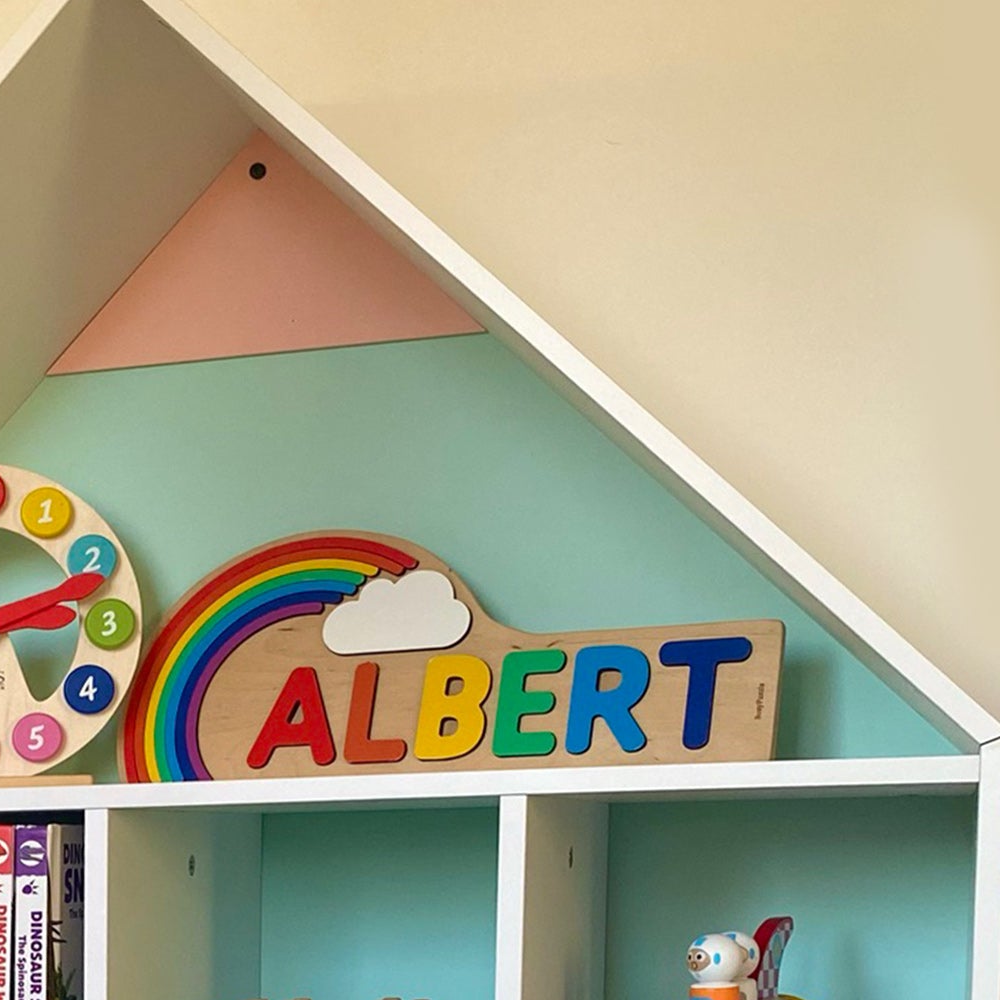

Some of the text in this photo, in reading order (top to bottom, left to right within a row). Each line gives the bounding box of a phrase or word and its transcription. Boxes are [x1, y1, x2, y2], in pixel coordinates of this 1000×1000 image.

[37, 499, 54, 524] 1
[83, 546, 102, 573] 2
[101, 610, 118, 637] 3
[79, 678, 97, 701] 4
[246, 637, 753, 769] ALBERT
[28, 725, 45, 751] 5
[18, 935, 27, 955] The
[30, 911, 43, 994] DINOSAUR
